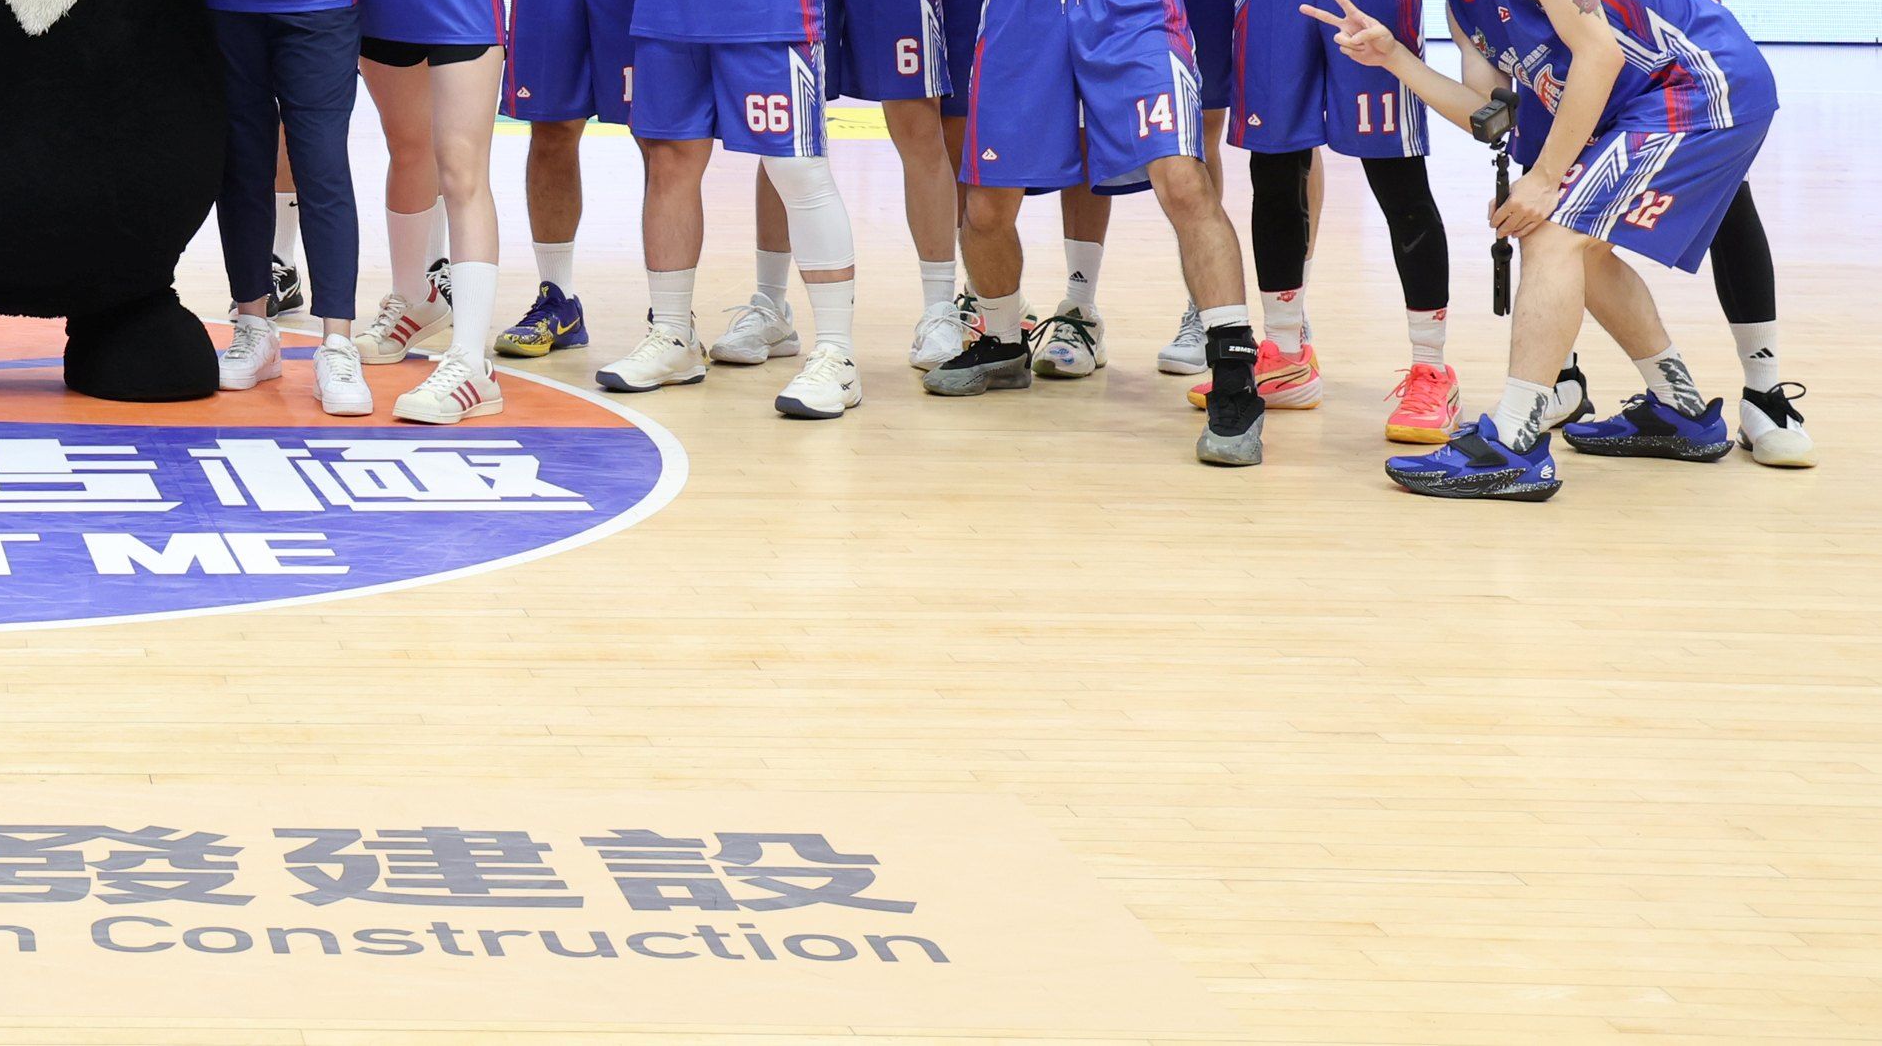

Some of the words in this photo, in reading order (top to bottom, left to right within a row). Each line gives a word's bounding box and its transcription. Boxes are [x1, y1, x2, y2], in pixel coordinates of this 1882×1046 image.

[896, 37, 920, 76] 6
[745, 93, 791, 133] 66
[1137, 93, 1173, 139] 14
[1357, 92, 1396, 134] 11
[1625, 189, 1674, 231] 12
[83, 533, 350, 575] ME
[90, 915, 953, 963] Construction
